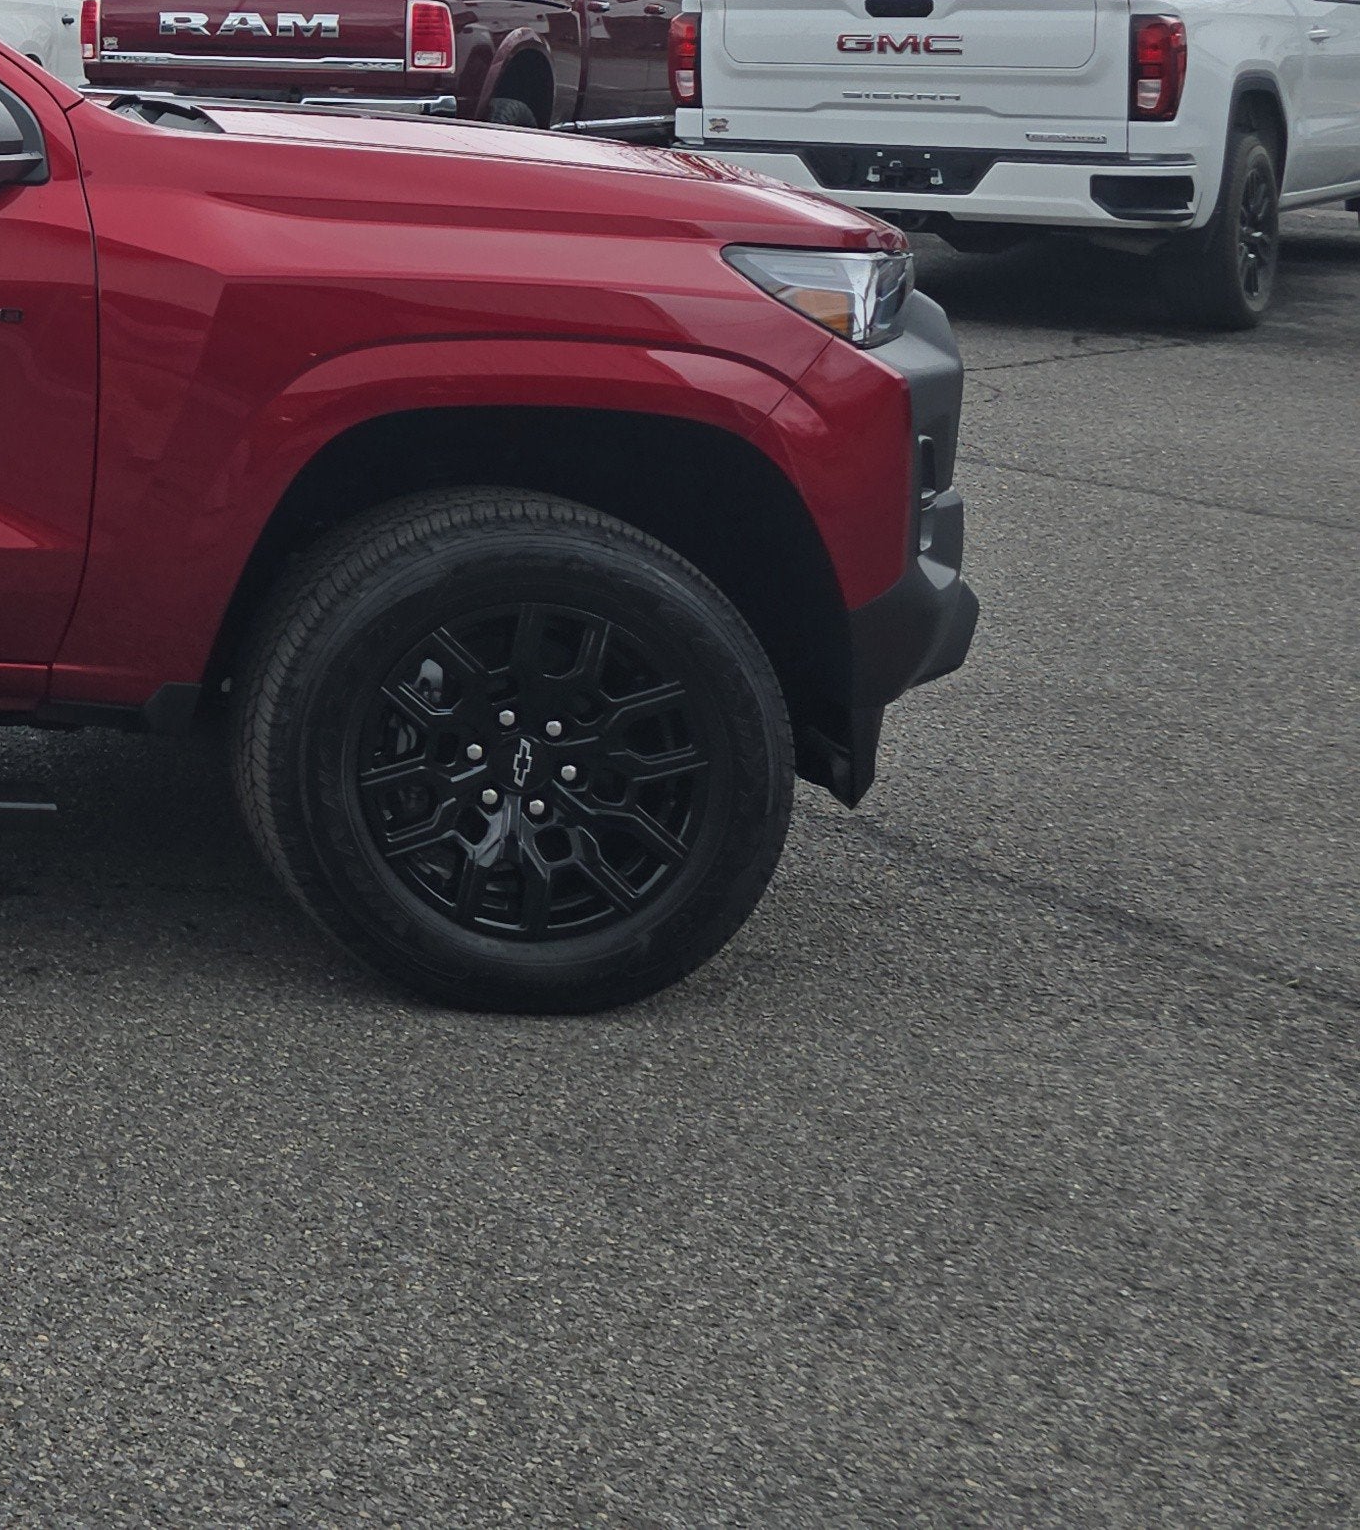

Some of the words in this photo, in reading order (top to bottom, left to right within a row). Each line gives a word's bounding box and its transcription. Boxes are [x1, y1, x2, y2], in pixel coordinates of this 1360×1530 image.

[159, 11, 339, 38] RAM
[836, 33, 963, 56] GMC
[842, 91, 961, 101] SIERRA
